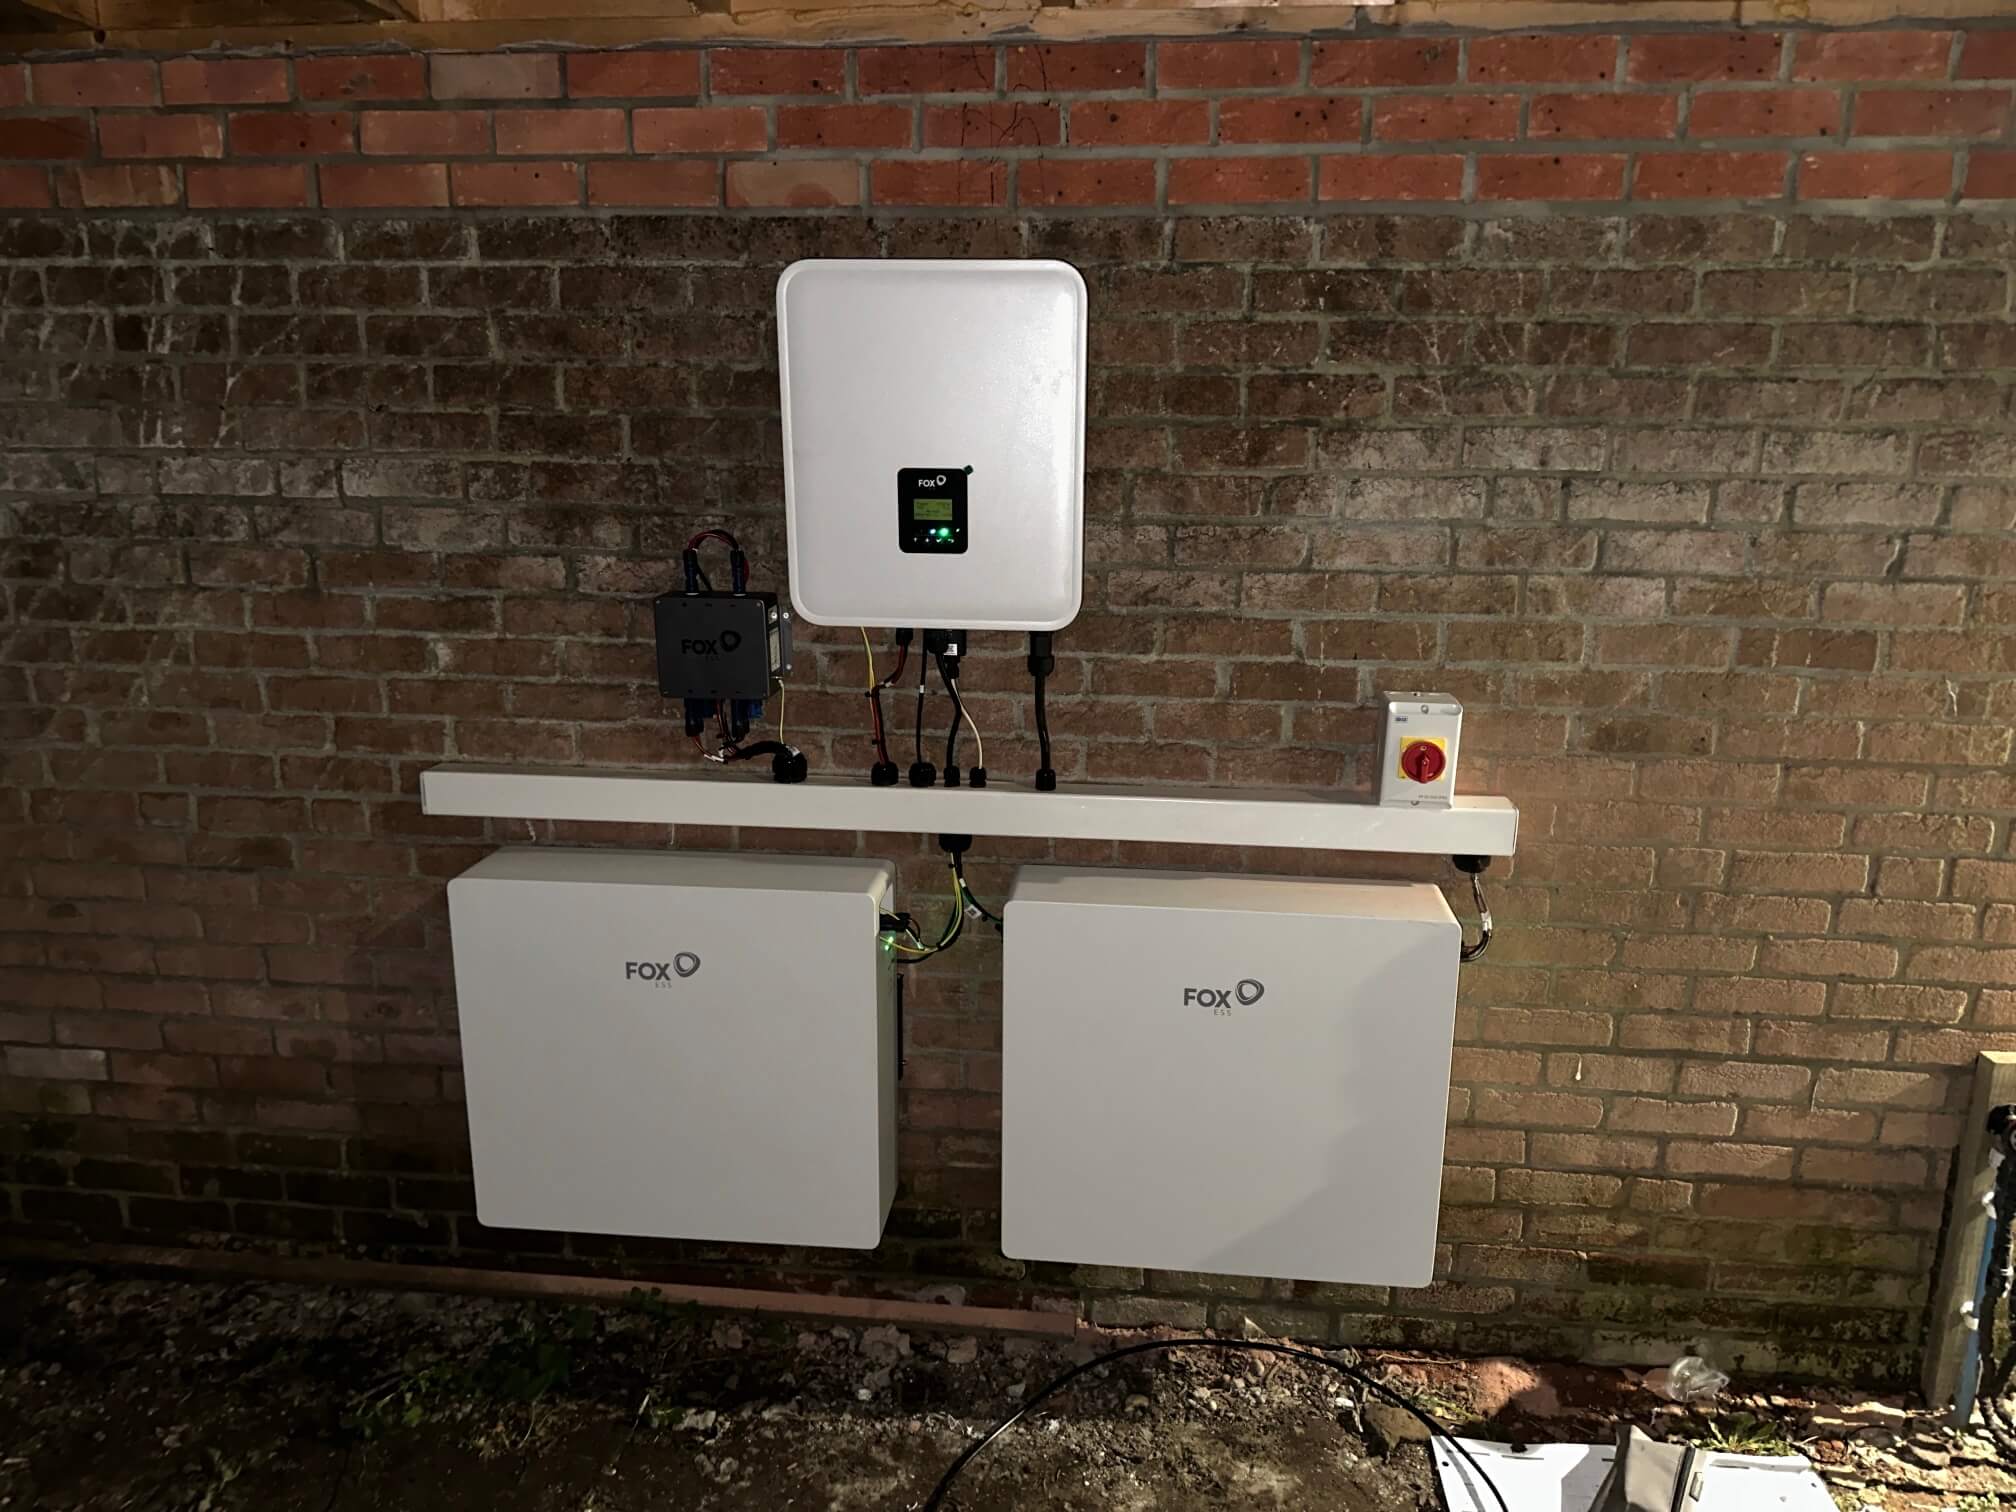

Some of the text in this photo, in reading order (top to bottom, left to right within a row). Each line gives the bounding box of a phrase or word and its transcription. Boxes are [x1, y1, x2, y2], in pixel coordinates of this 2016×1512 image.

[918, 479, 936, 488] FOX
[681, 639, 718, 655] FOX
[625, 961, 671, 981] FOX
[1183, 988, 1233, 1009] FOX
